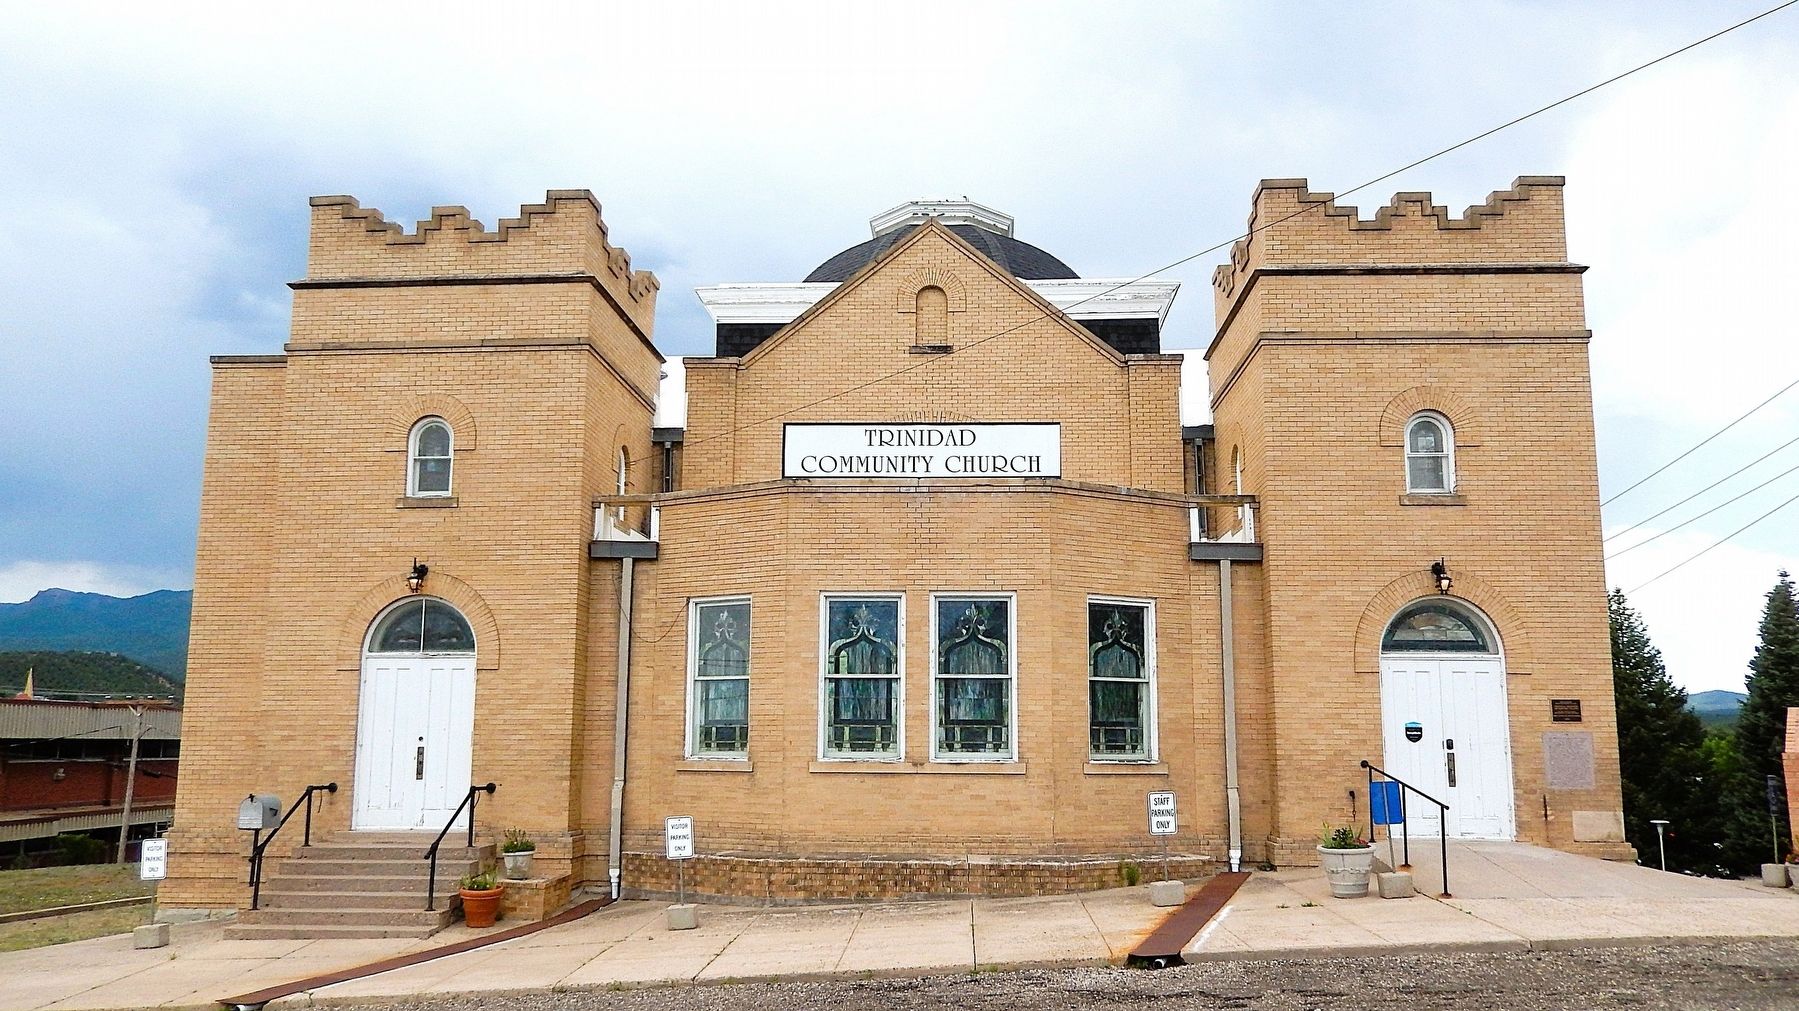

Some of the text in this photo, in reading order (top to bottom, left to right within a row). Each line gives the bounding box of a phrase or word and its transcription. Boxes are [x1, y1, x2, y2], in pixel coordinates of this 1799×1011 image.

[864, 429, 977, 447] TRINIDAD
[800, 455, 1042, 473] COMMUNITY CHURCH
[1153, 796, 1170, 806] STAFF
[1151, 808, 1175, 817] PARKING
[1156, 820, 1170, 829] ONLY
